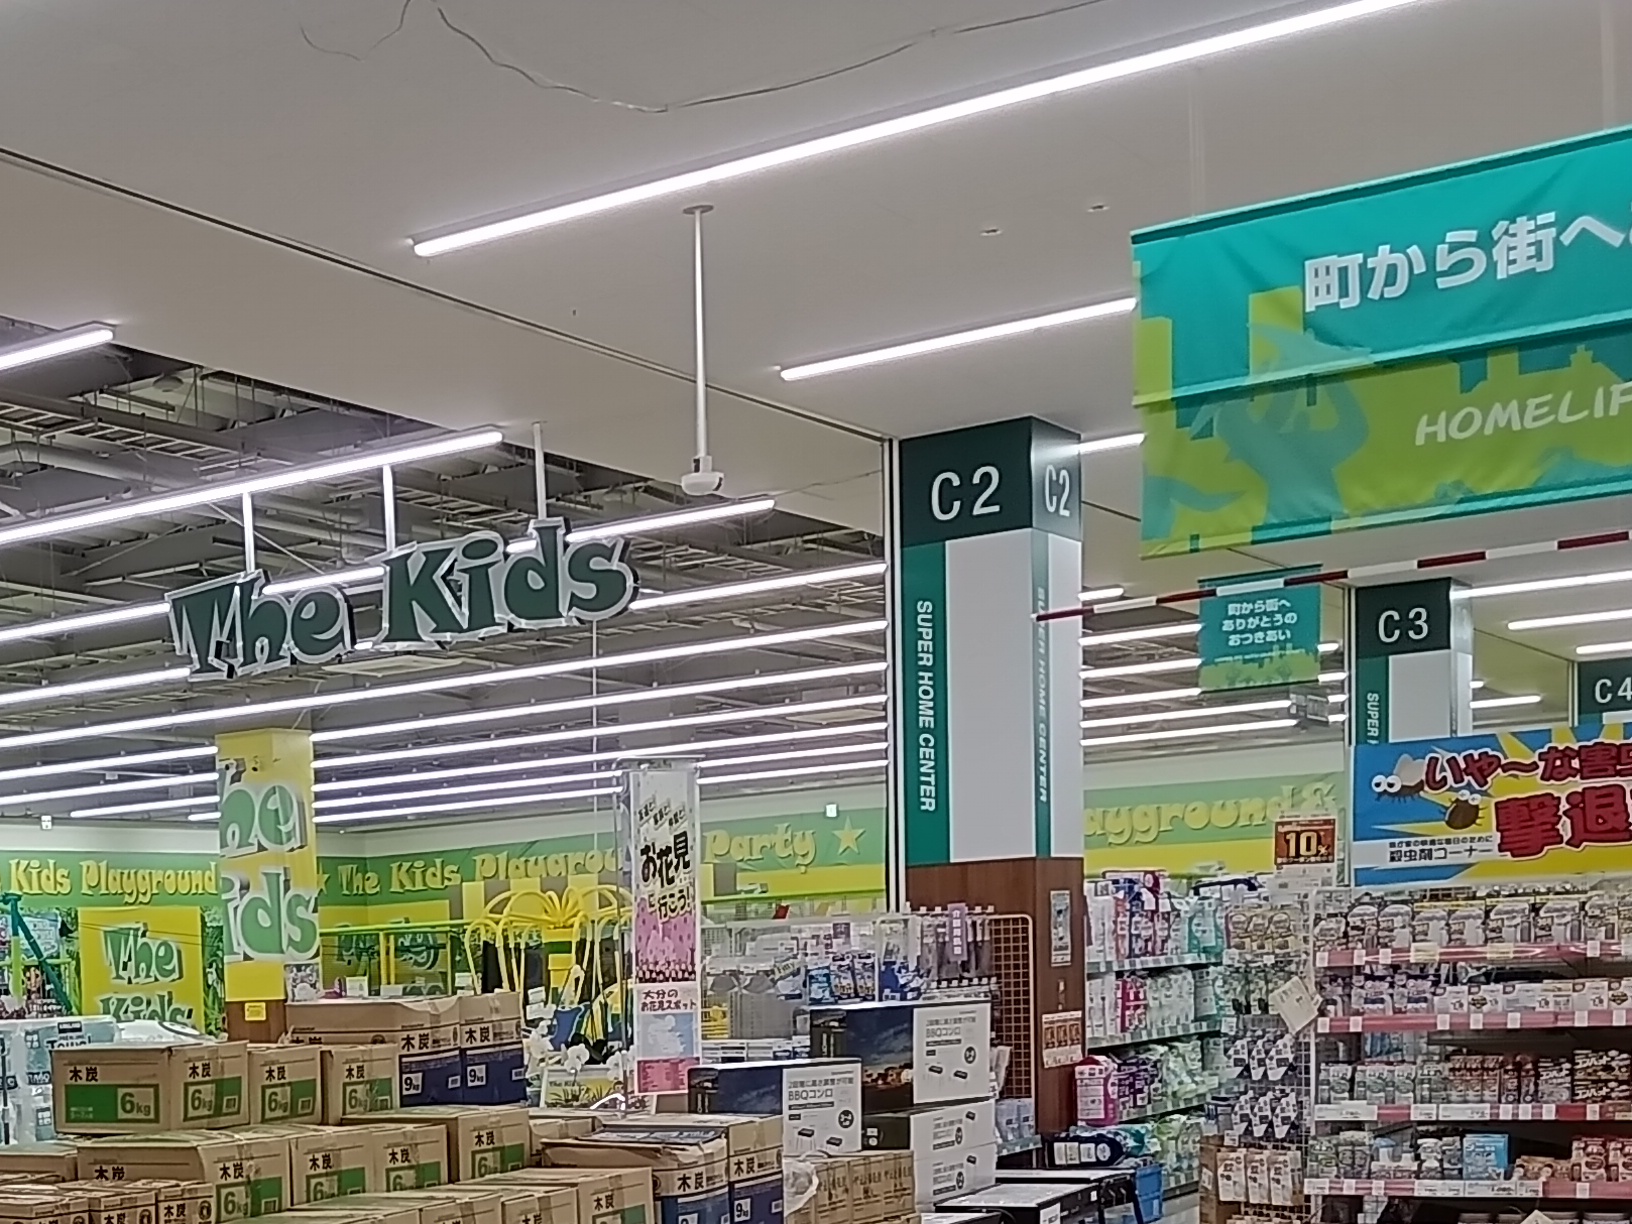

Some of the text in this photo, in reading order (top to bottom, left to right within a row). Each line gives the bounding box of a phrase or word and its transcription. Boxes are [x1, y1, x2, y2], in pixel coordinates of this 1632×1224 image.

[1304, 210, 1632, 313] 町から街へ
[930, 465, 1002, 523] C2
[1043, 460, 1072, 520] C2
[168, 525, 637, 678] The Kids
[1222, 612, 1298, 631] ありがとうの
[1228, 598, 1291, 616] 町から街へ
[1228, 630, 1291, 646] おつきあい
[1378, 607, 1429, 643] C3
[916, 600, 936, 812] SUPER HOME CENTER
[1367, 692, 1380, 737] SUPER
[1038, 723, 1047, 803] CENTER
[640, 831, 691, 888] お花見
[703, 822, 817, 874] Party
[9, 858, 72, 895] Kids
[80, 858, 219, 905] Playground
[338, 864, 381, 896] The
[389, 858, 462, 893] Kids
[102, 922, 184, 985] The
[641, 1000, 697, 1012] お花見スポット
[643, 989, 678, 999] 大分の
[401, 1033, 430, 1051] 木炭
[69, 1067, 98, 1082] 木炭
[788, 1087, 834, 1101] BBQコンロ
[120, 1092, 151, 1116] 6kg
